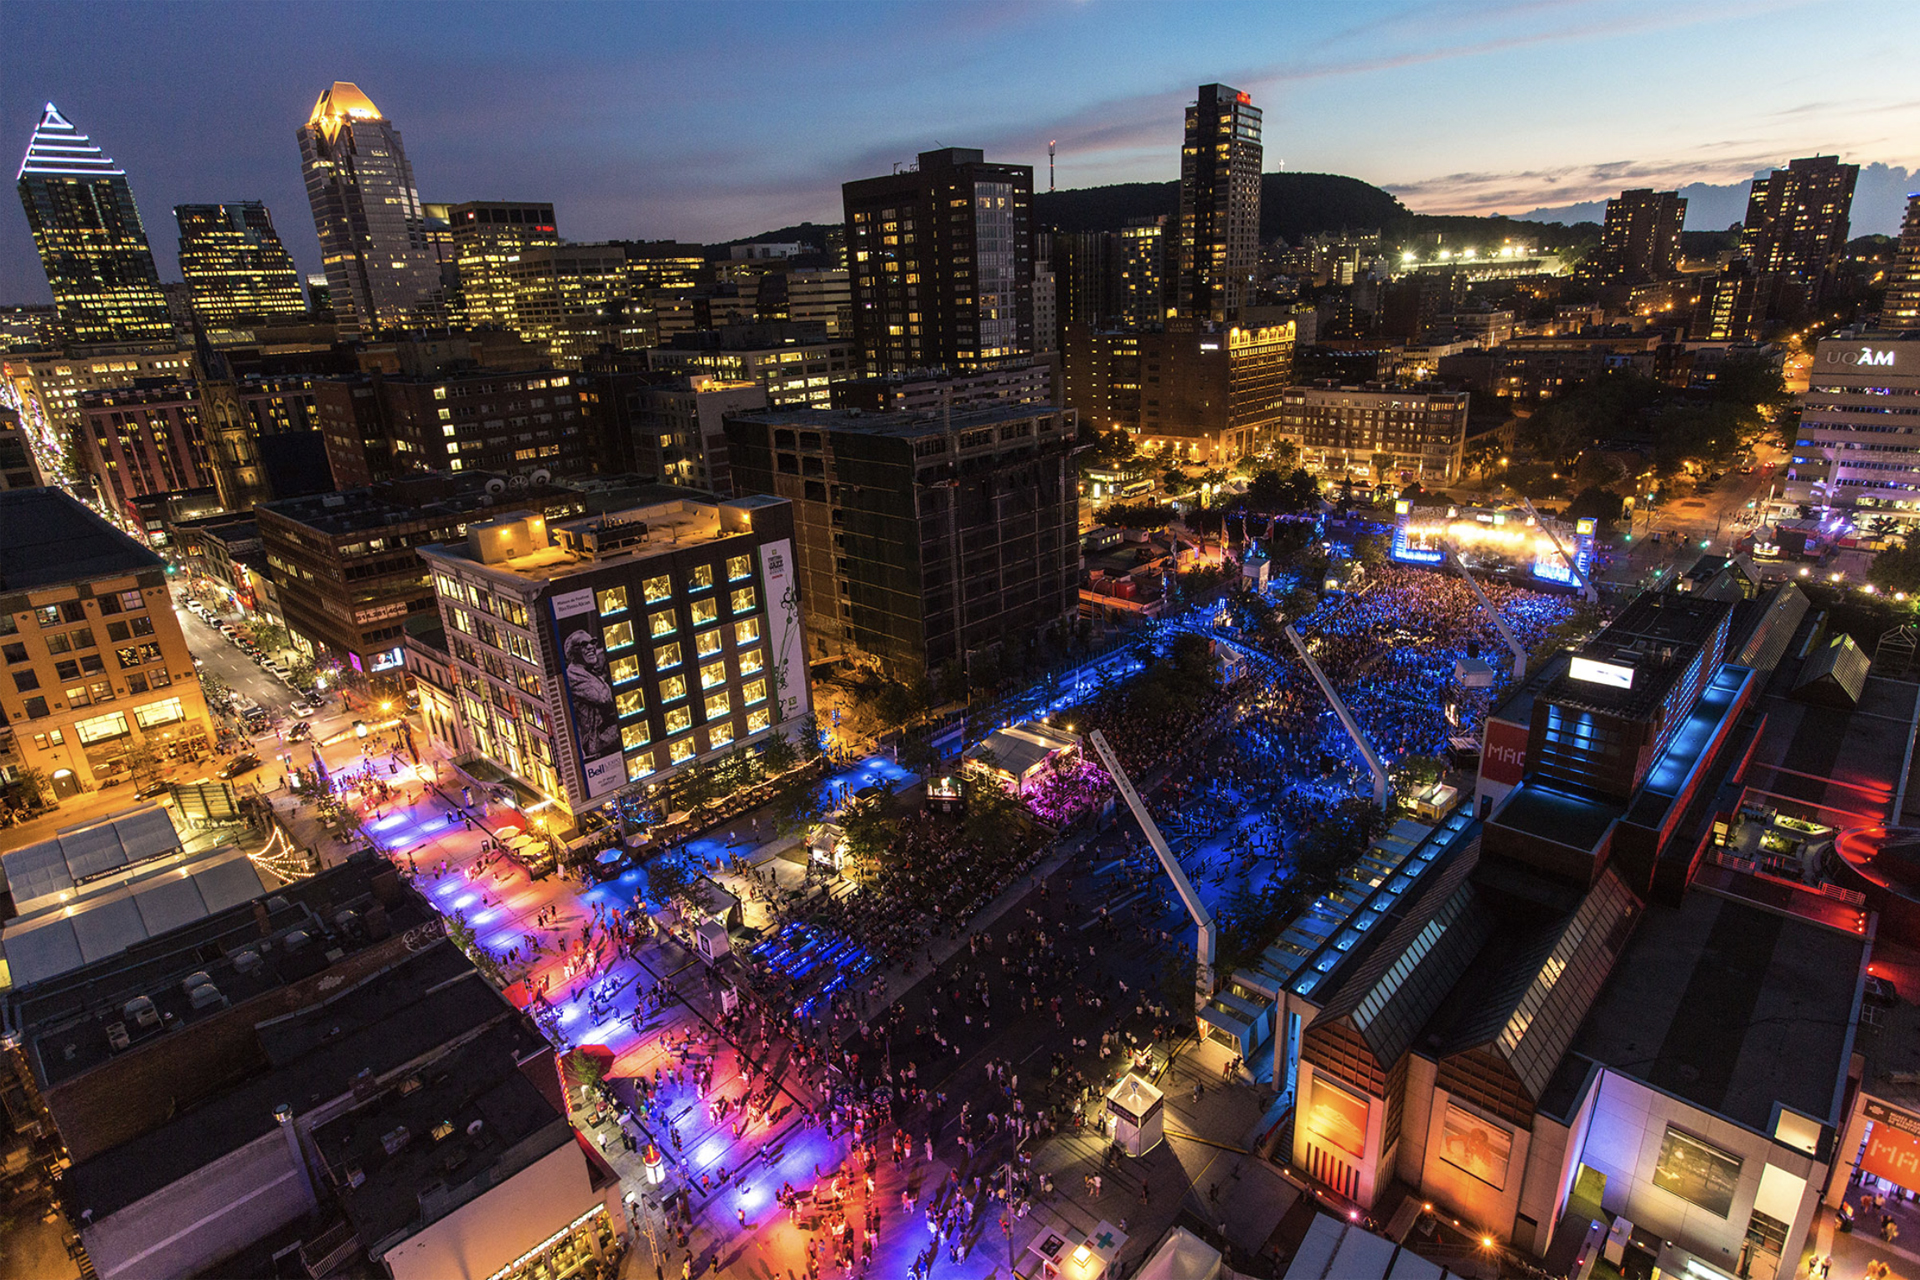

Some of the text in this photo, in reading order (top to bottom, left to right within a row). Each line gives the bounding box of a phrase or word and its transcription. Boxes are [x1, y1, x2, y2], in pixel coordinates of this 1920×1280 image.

[769, 560, 784, 569] JAZZ
[1487, 742, 1526, 767] MAC
[587, 763, 605, 778] Bell
[1870, 1138, 1920, 1174] MA
